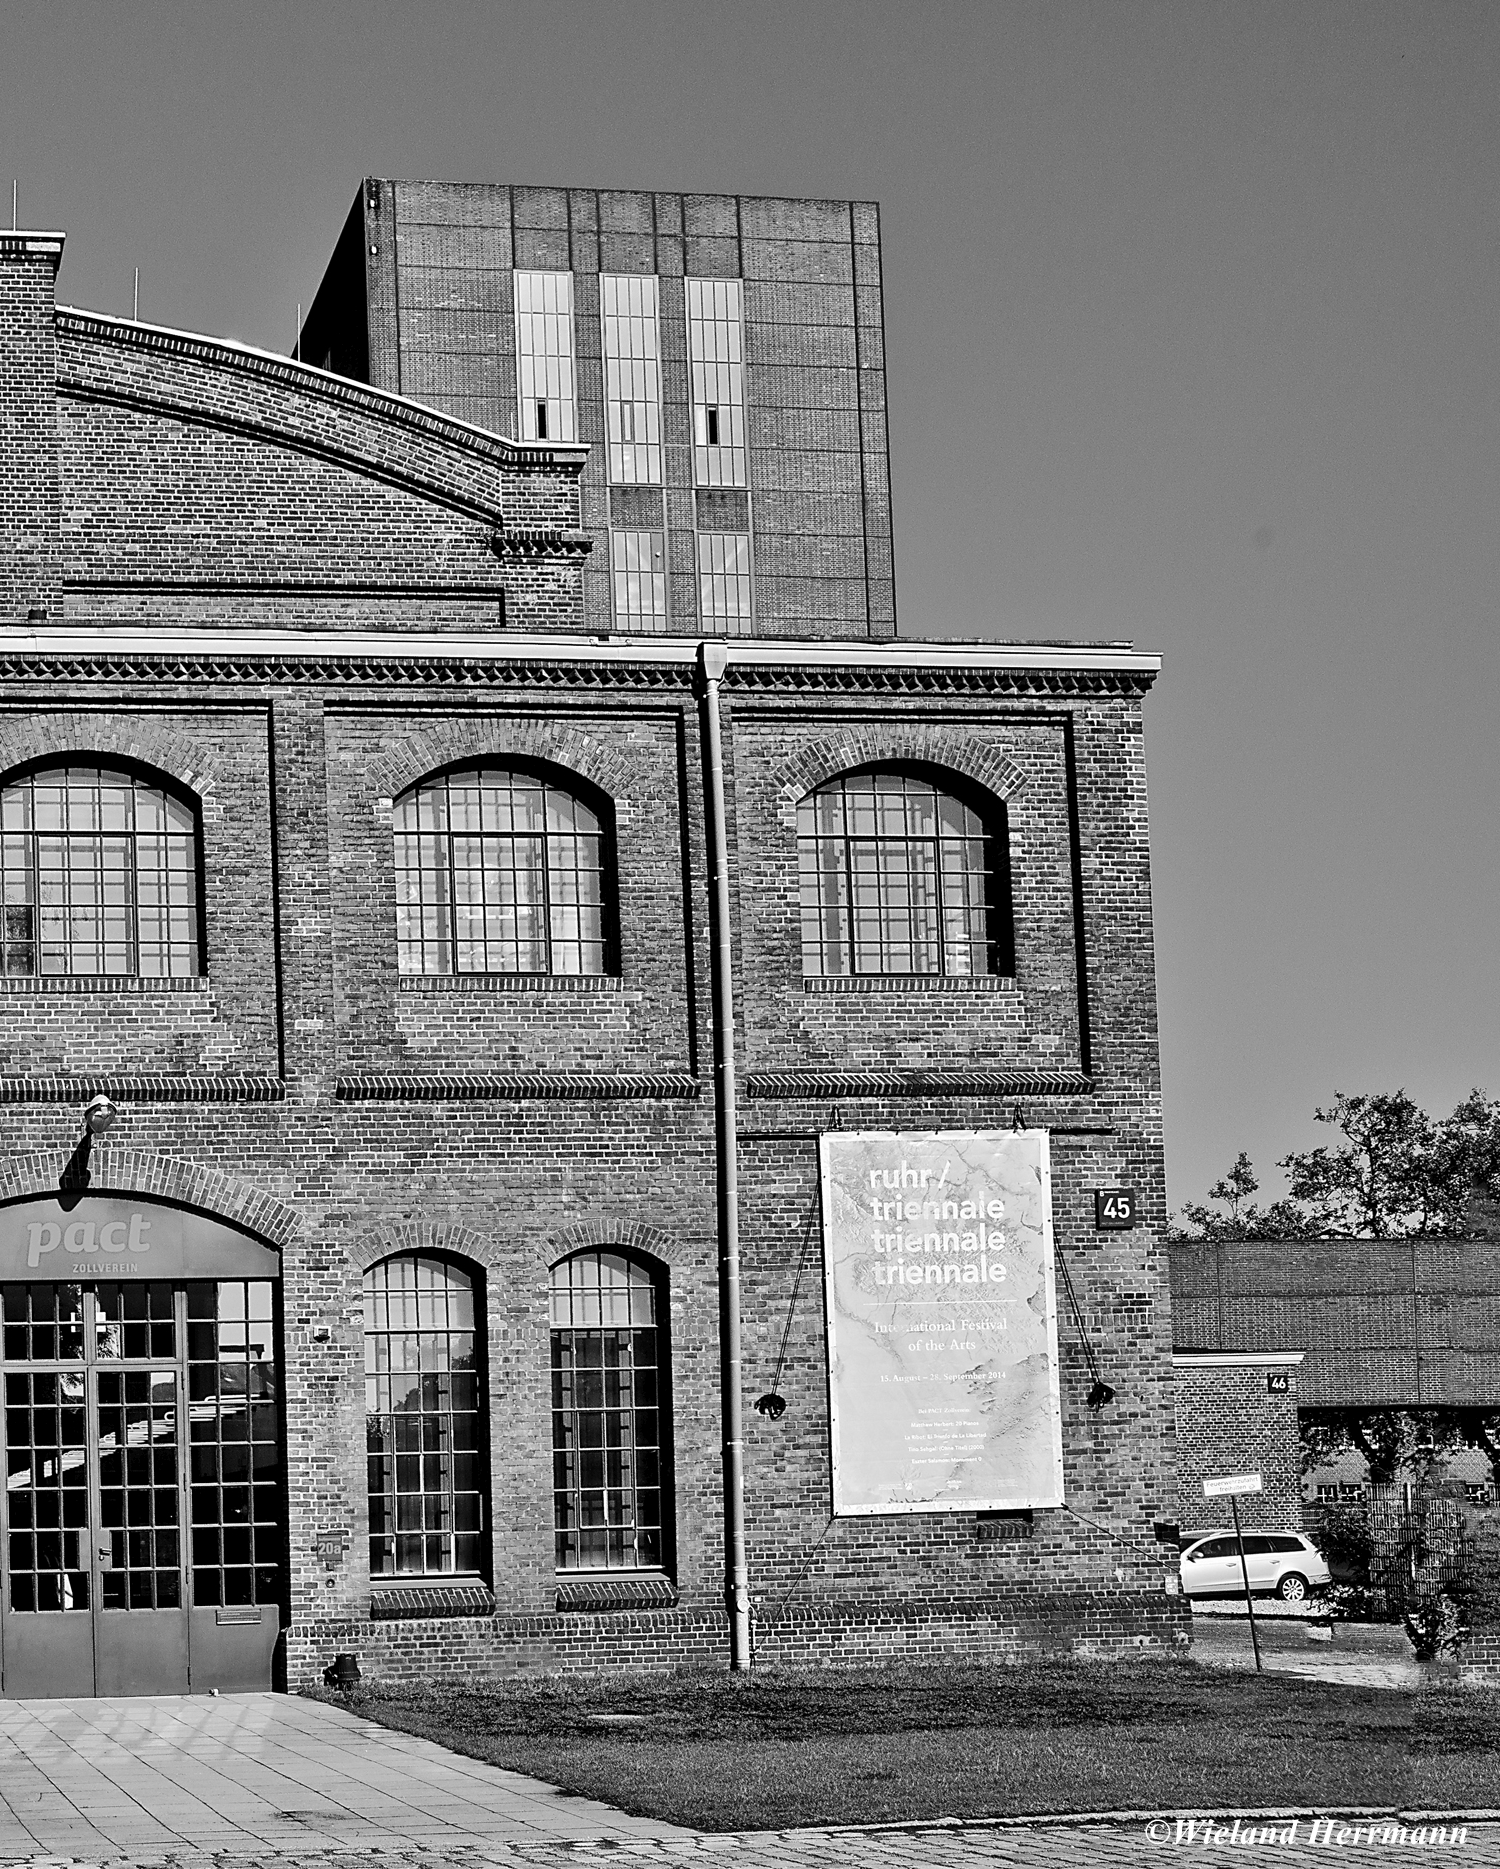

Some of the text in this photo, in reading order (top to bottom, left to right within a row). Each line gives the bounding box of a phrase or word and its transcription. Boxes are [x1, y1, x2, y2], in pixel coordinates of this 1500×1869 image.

[870, 1160, 932, 1189] ruhr
[870, 1191, 1005, 1221] triennale
[1103, 1197, 1130, 1219] 45
[27, 1213, 151, 1267] pact
[871, 1223, 1006, 1252] triennale
[72, 1263, 138, 1273] ZOLLVEREIN
[873, 1255, 1007, 1284] triennale
[961, 1318, 1008, 1331] Festival
[908, 1338, 976, 1352] of the Arts
[893, 1374, 921, 1383] August
[930, 1373, 942, 1381] 28.
[943, 1372, 986, 1382] September
[988, 1371, 1006, 1379] 2014
[1271, 1377, 1286, 1388] 46
[318, 1542, 341, 1555] 20a
